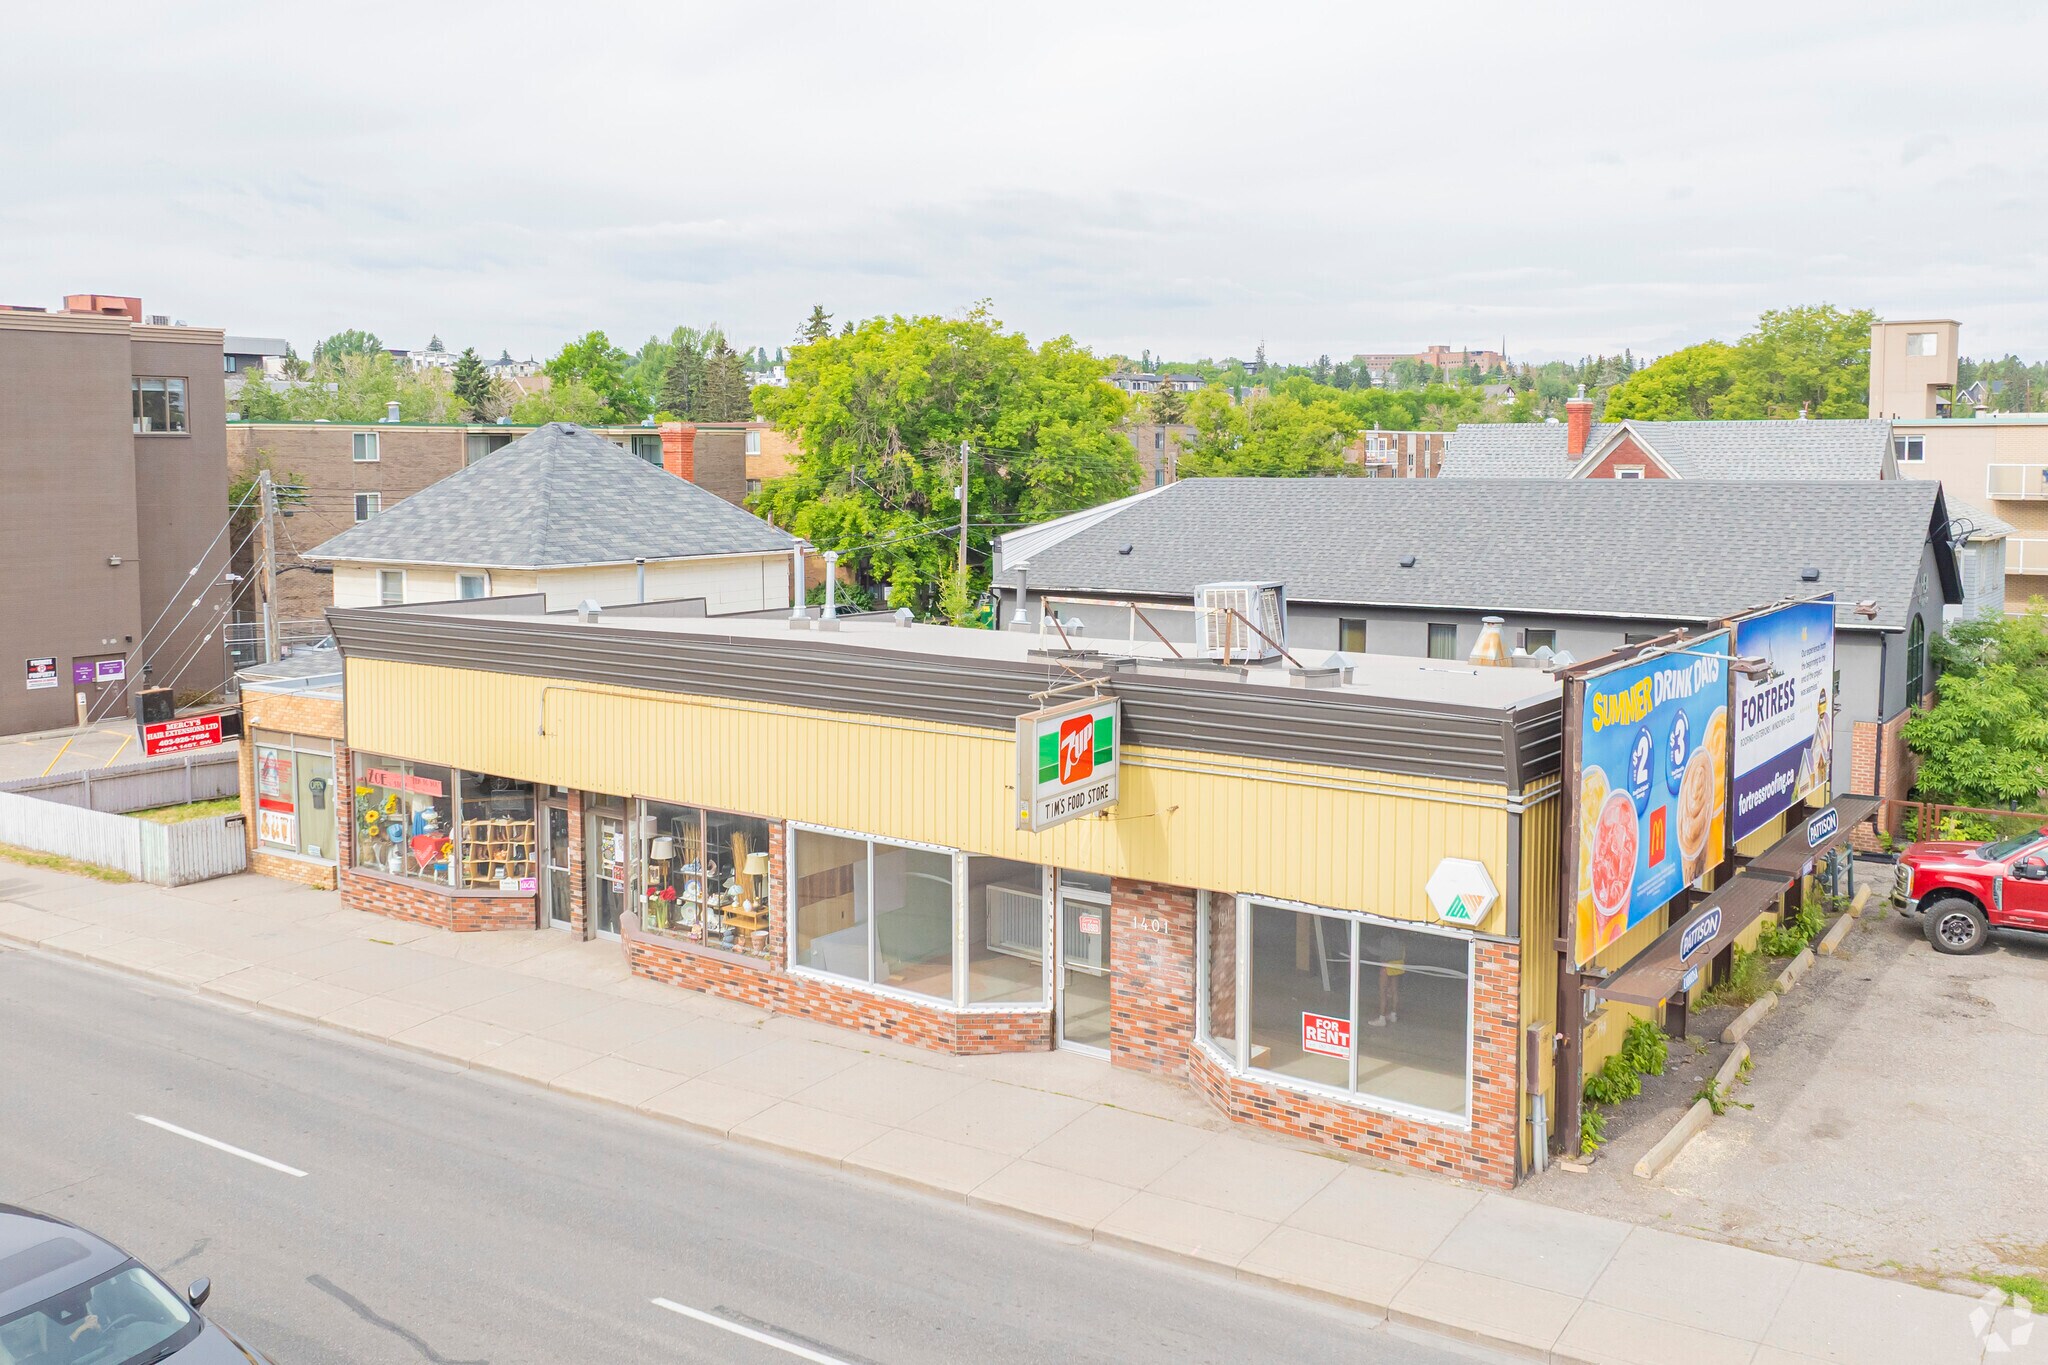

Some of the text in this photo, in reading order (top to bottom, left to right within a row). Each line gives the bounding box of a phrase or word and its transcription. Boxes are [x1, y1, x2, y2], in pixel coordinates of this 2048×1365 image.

[1592, 652, 1720, 732] SUMMER DRINK DAYS
[1741, 678, 1795, 731] FORTRESS
[147, 722, 218, 740] HAIR EXTENSIONS LTD
[166, 719, 200, 730] MERCY'S
[1045, 784, 1108, 819] TIM'S FOOD STORE
[1738, 768, 1794, 816] fortressroofing.ca
[1810, 814, 1836, 842] PATTISON
[1133, 916, 1168, 934] 1401
[1684, 914, 1718, 955] PATTISON
[1306, 1026, 1350, 1046] RENT
[1316, 1018, 1339, 1032] FOR
